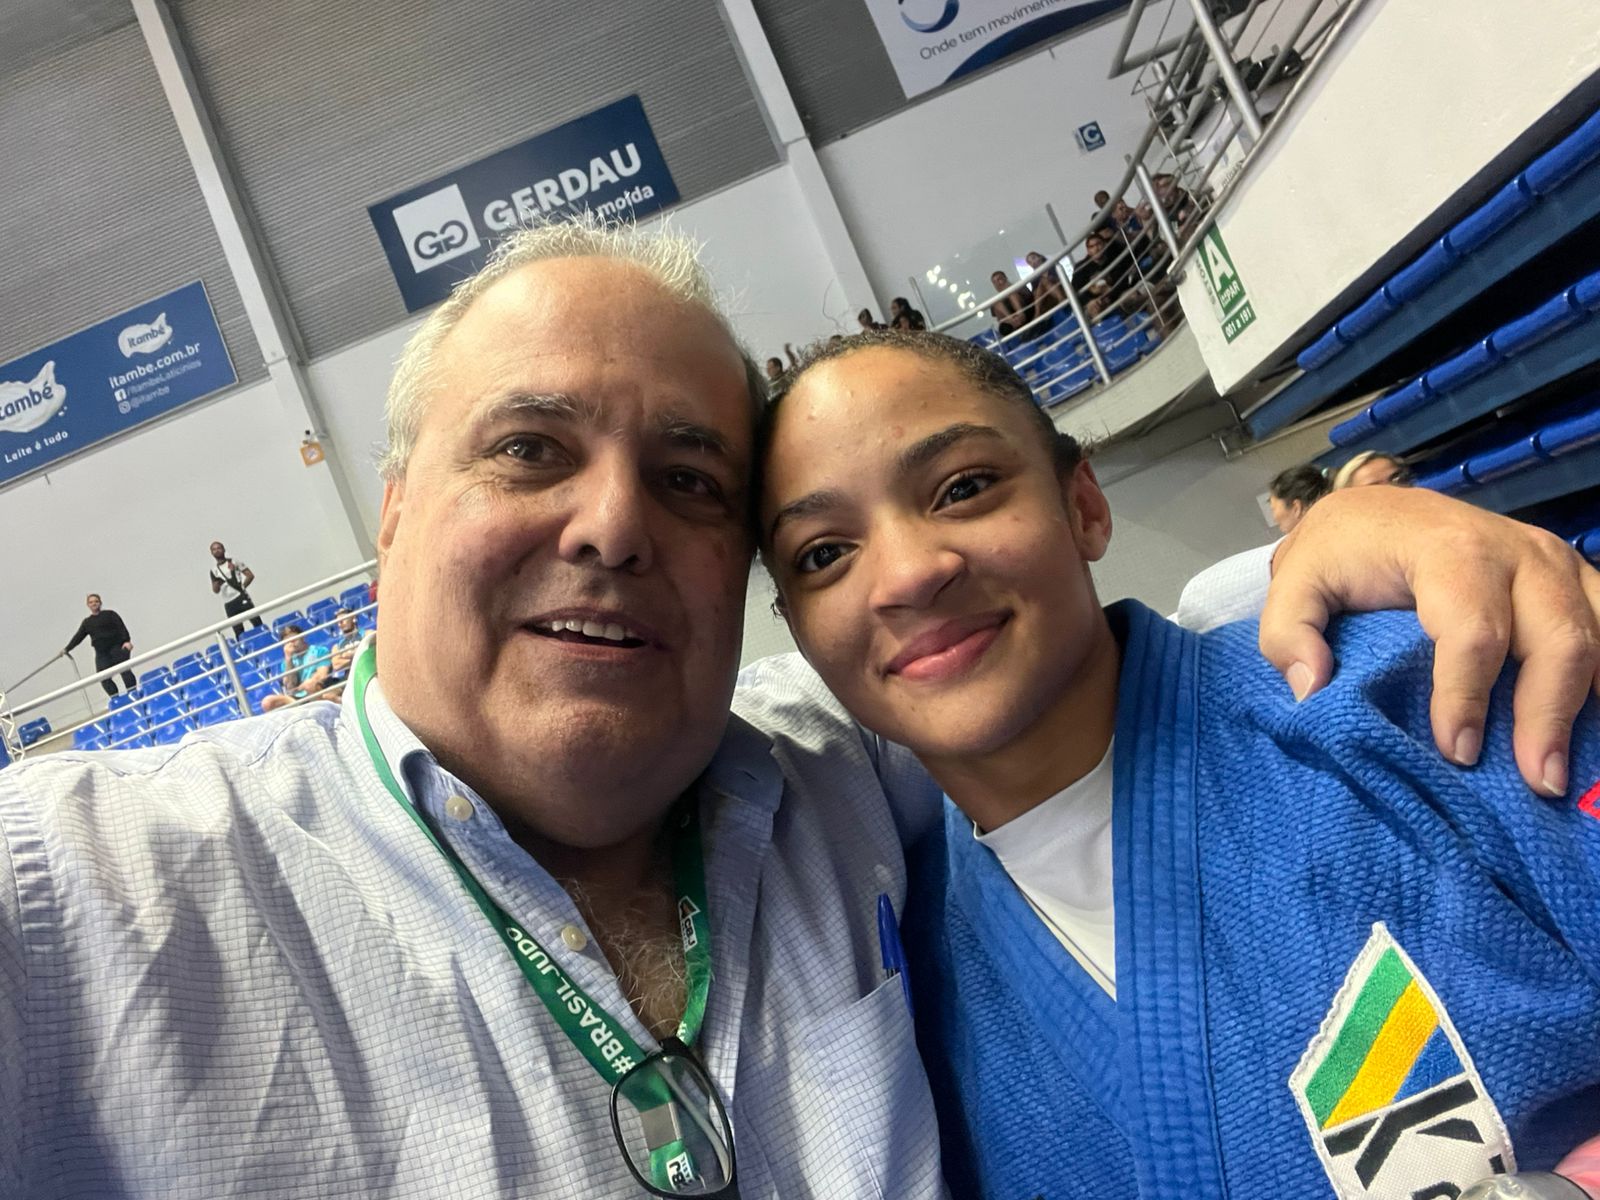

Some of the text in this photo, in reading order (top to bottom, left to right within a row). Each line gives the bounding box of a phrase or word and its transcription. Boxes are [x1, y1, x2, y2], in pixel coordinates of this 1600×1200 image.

[919, 0, 1062, 60] Onde tem movimen
[1083, 125, 1101, 143] C
[483, 143, 642, 231] GERDAU
[1203, 233, 1235, 293] A
[4, 445, 33, 464] Leite
[43, 429, 69, 447] tudo
[556, 976, 636, 1074] #BRASIL
